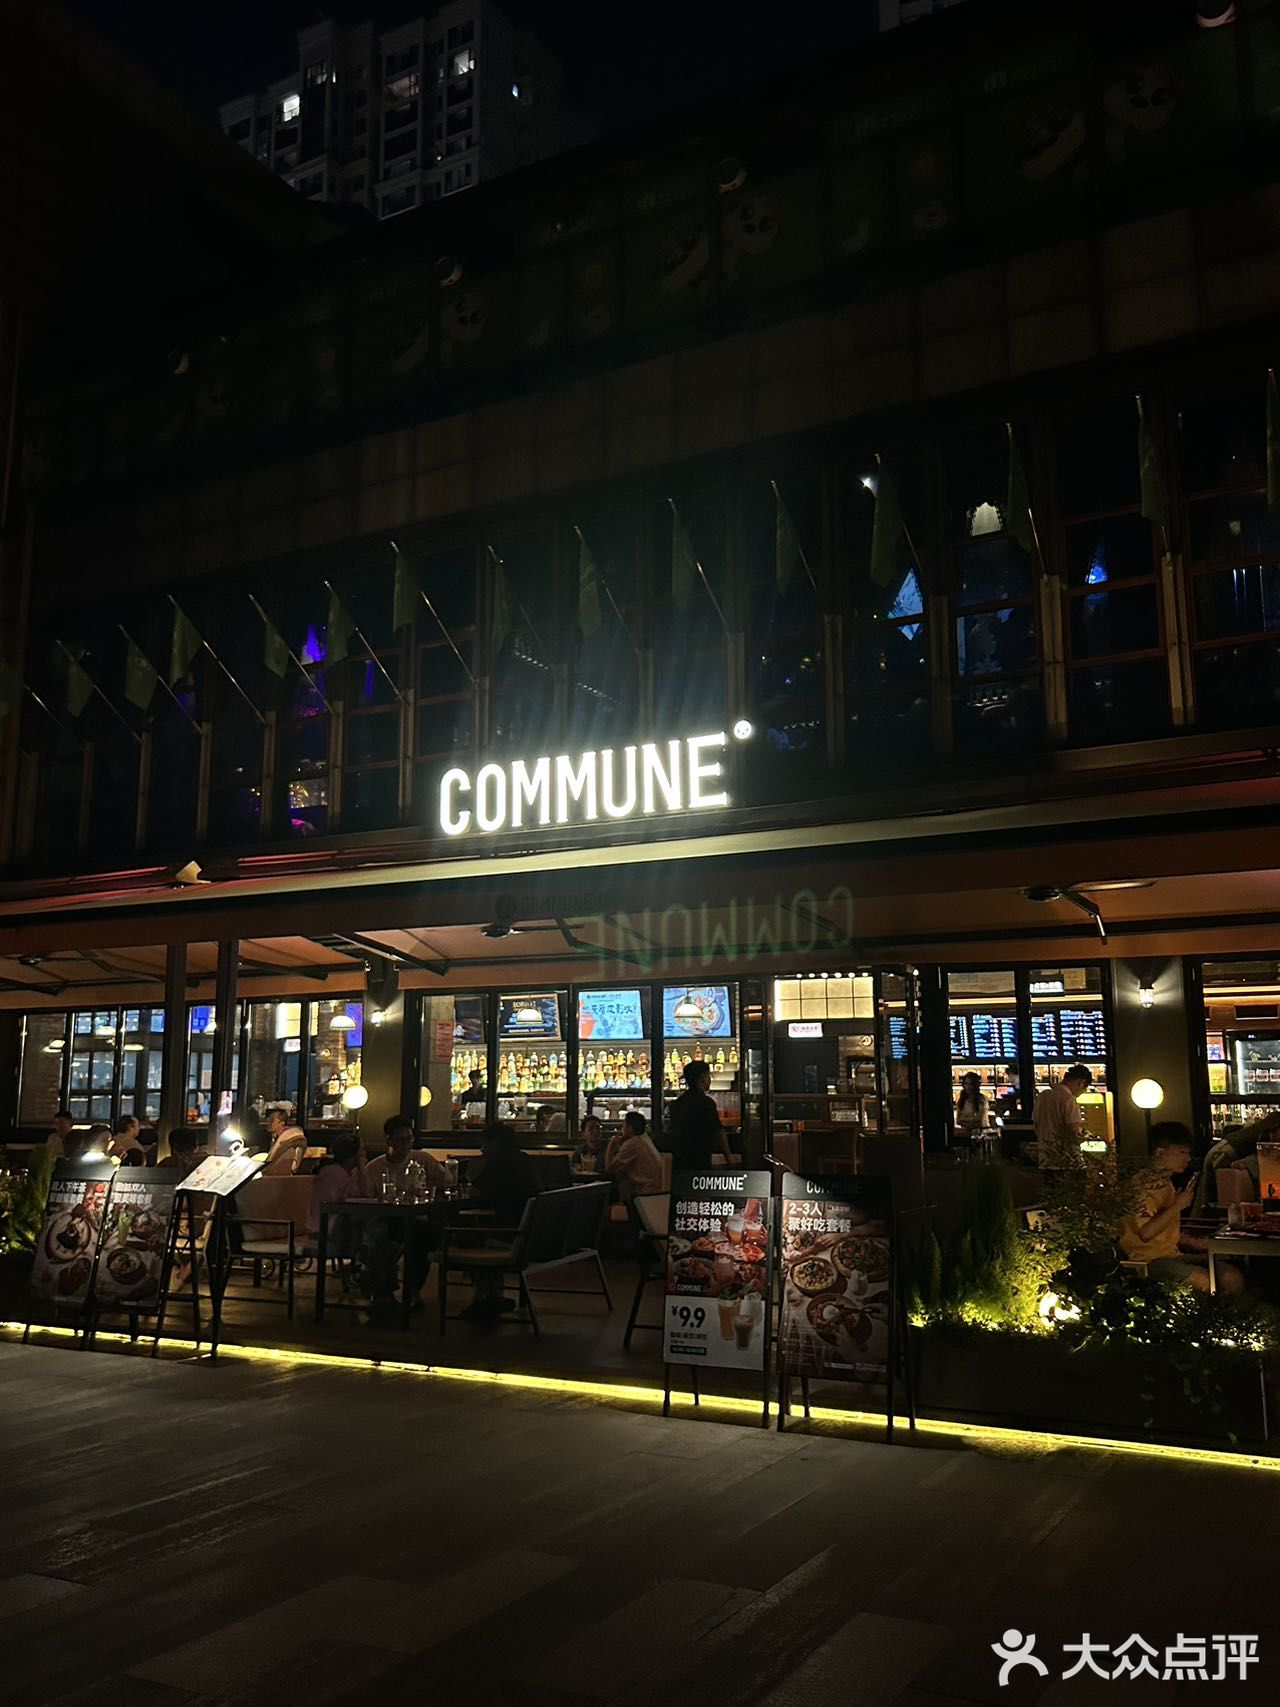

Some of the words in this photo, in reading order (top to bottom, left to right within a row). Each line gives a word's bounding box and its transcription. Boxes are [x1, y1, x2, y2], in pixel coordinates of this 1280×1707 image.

[440, 730, 728, 836] COMMUNE
[692, 1176, 745, 1191] COMMUNE
[675, 1201, 735, 1216] 创造轻松的
[788, 1201, 823, 1216] 2-3人
[674, 1217, 722, 1232] 社交体验
[671, 1305, 706, 1328] ¥9.9
